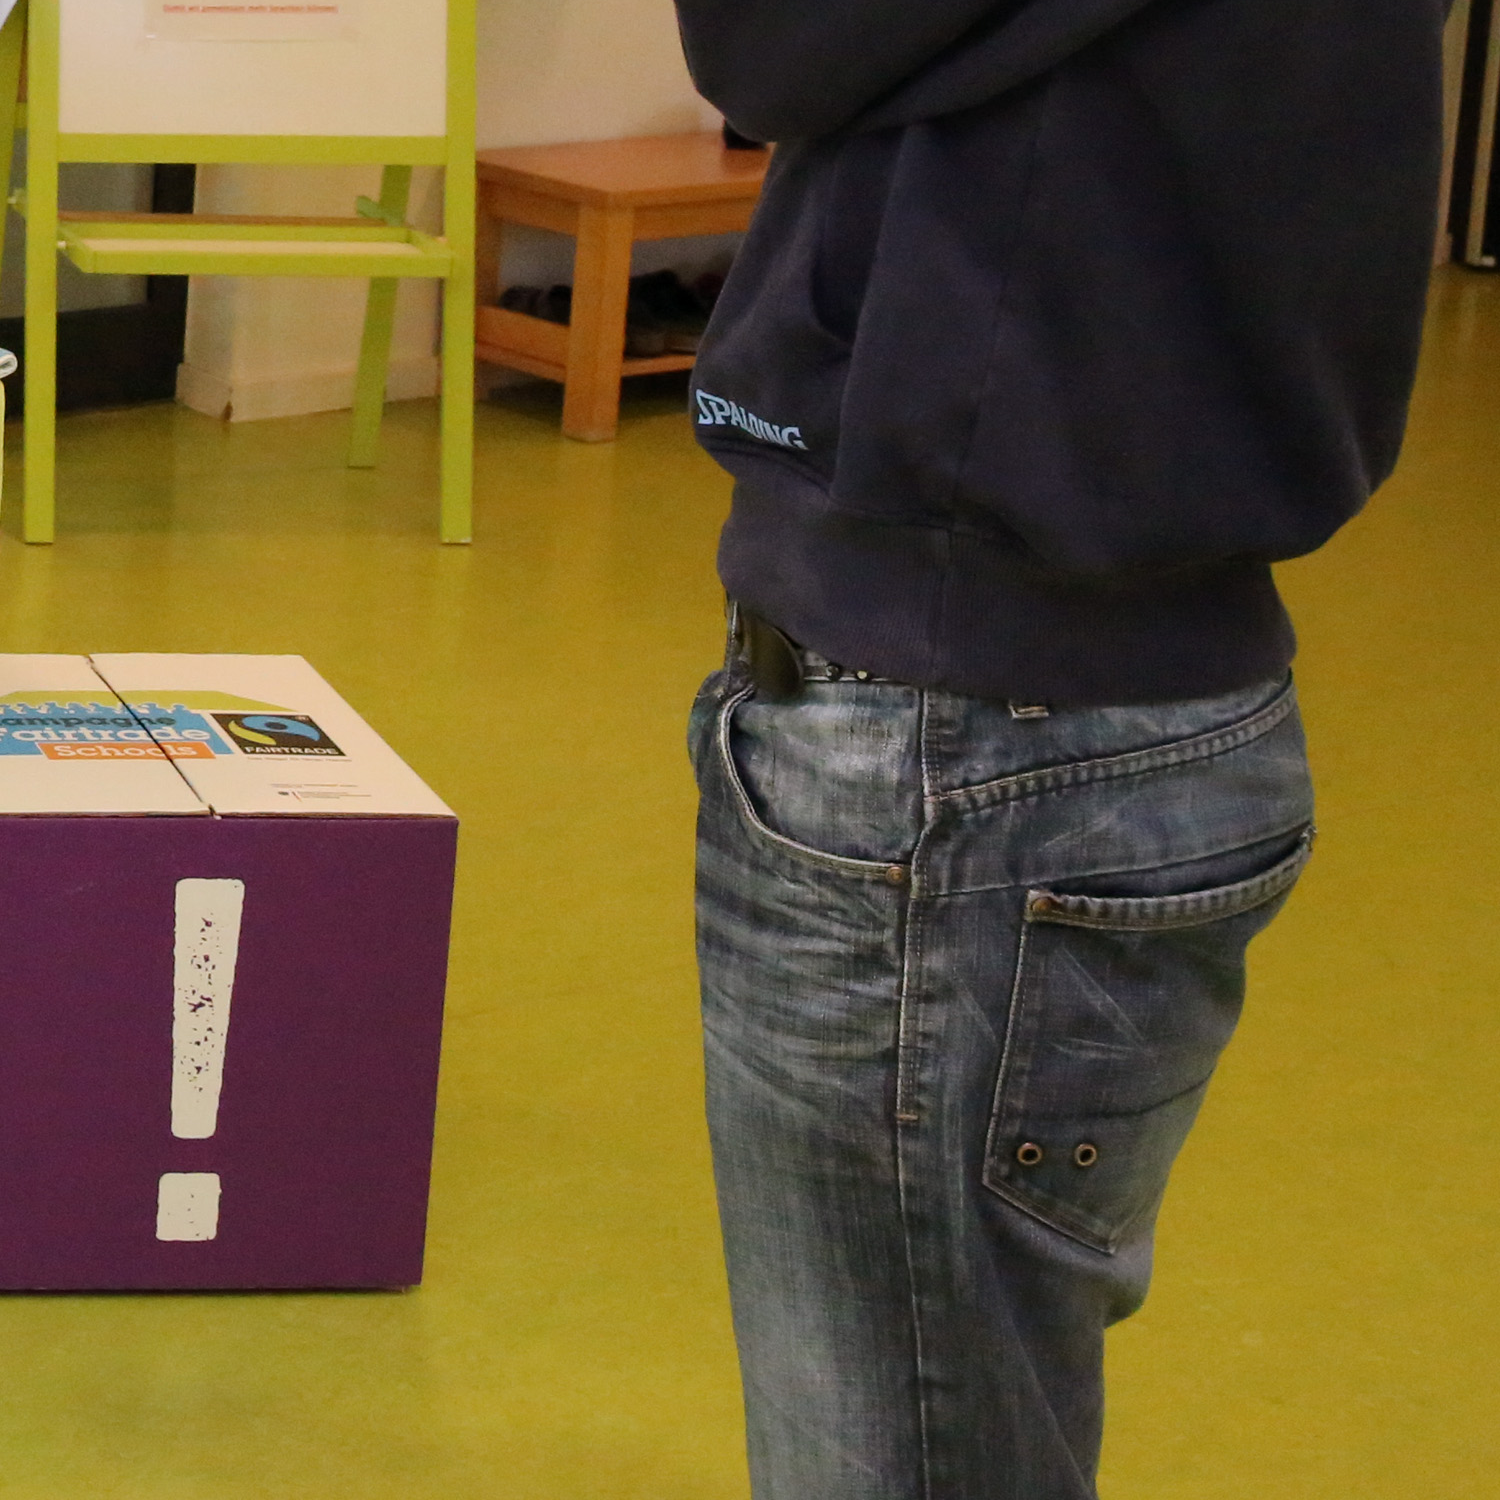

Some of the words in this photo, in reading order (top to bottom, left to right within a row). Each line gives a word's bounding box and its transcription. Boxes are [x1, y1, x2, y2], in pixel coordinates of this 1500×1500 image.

[696, 389, 809, 450] SPALDING
[52, 741, 198, 759] Schools
[244, 746, 340, 756] FAIRTRADE
[155, 878, 246, 1241] !
